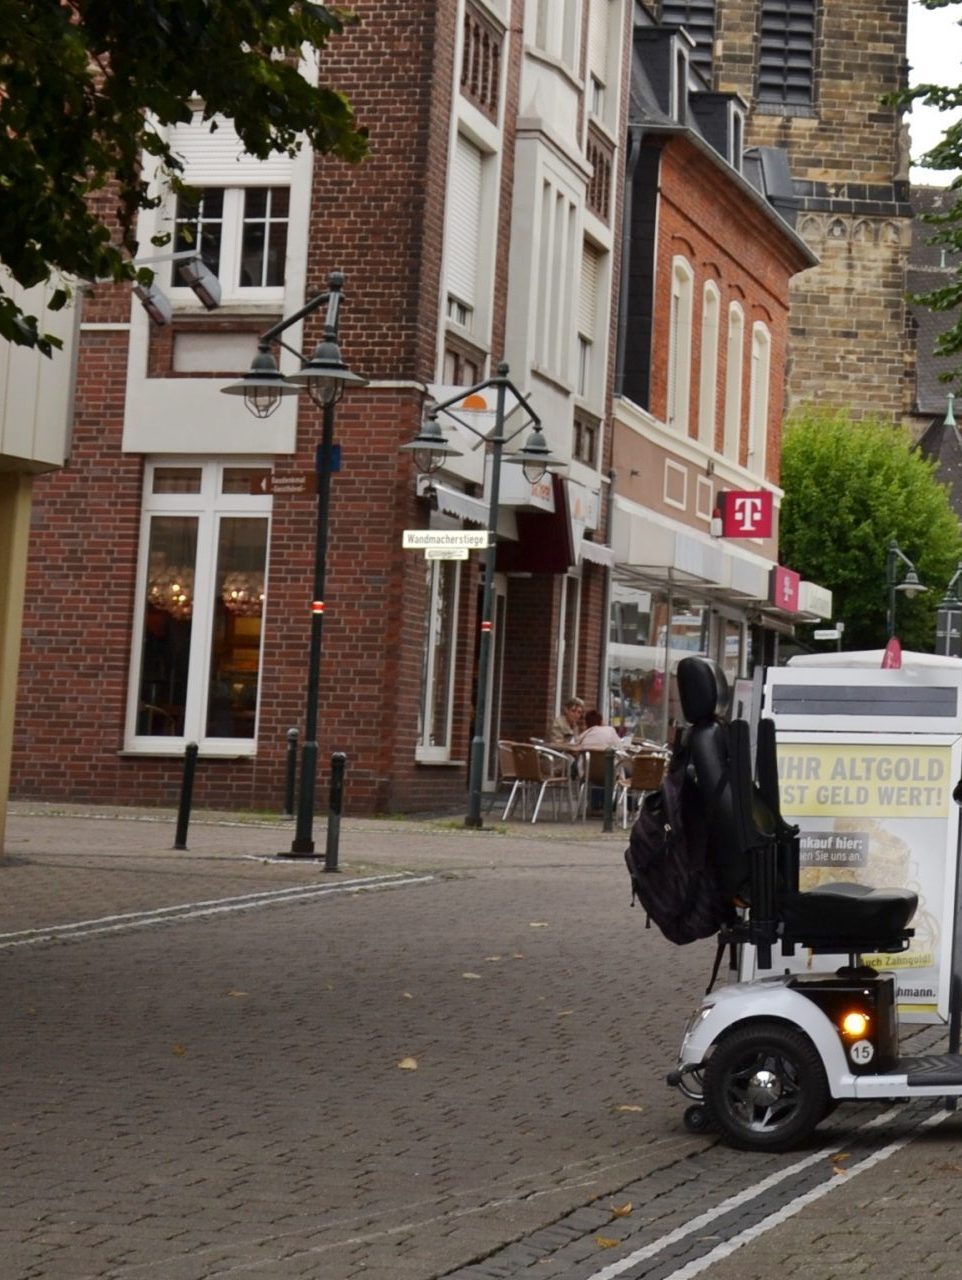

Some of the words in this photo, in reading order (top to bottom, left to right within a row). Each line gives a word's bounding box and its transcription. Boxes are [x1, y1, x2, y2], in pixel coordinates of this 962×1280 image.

[735, 498, 762, 531] T
[831, 757, 944, 781] ALTGOLD
[816, 786, 869, 806] GELD
[878, 786, 942, 807] WERT!
[799, 836, 833, 849] nkauf
[836, 836, 863, 849] hier:
[815, 850, 829, 861] Sie
[831, 852, 846, 861] uns
[865, 957, 882, 968] uch
[897, 987, 936, 997] hmann.
[853, 1046, 870, 1059] 15
